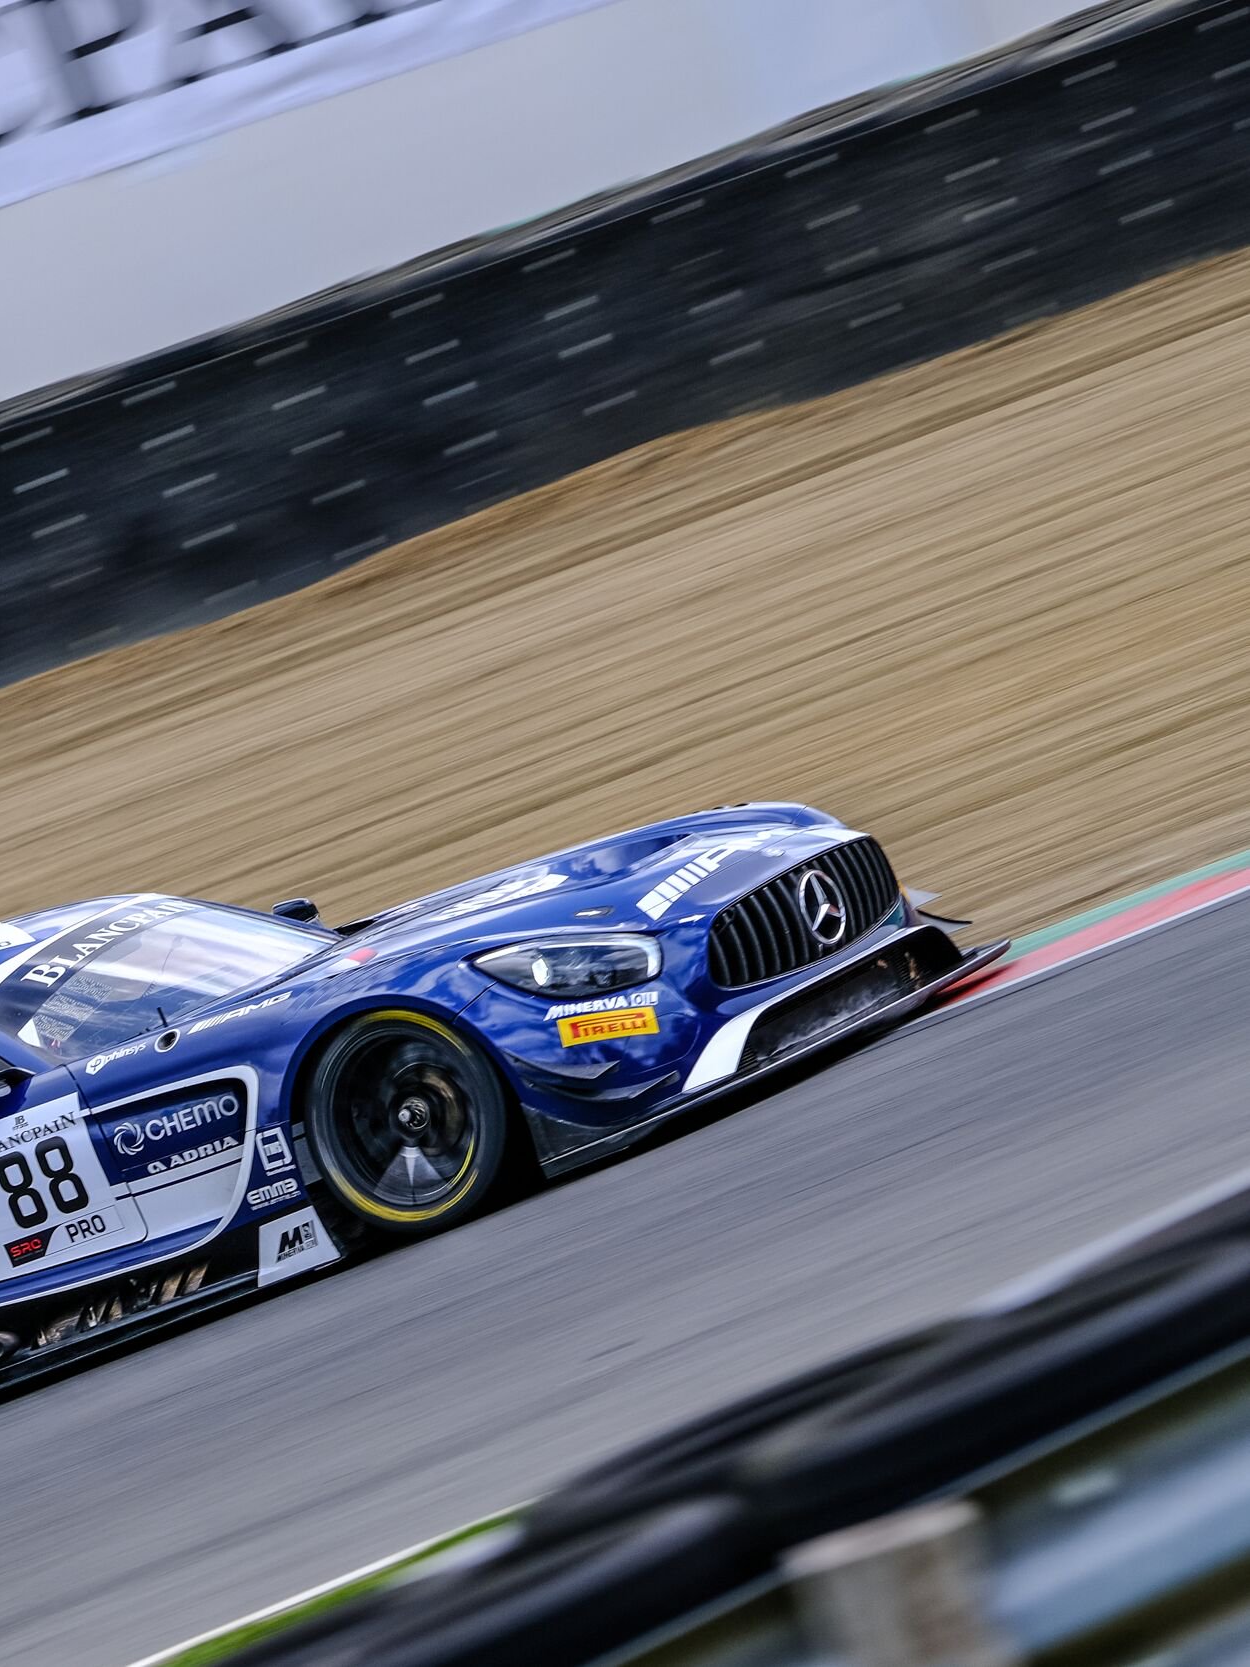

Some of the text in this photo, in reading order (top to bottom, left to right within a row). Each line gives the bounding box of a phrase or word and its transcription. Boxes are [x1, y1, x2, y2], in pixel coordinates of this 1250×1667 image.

[543, 991, 658, 1021] MINERVA OIL
[570, 1012, 647, 1039] PIRELLI
[144, 1095, 239, 1141] CHEMO
[170, 1136, 239, 1168] ADRIA
[64, 1214, 107, 1243] PRO
